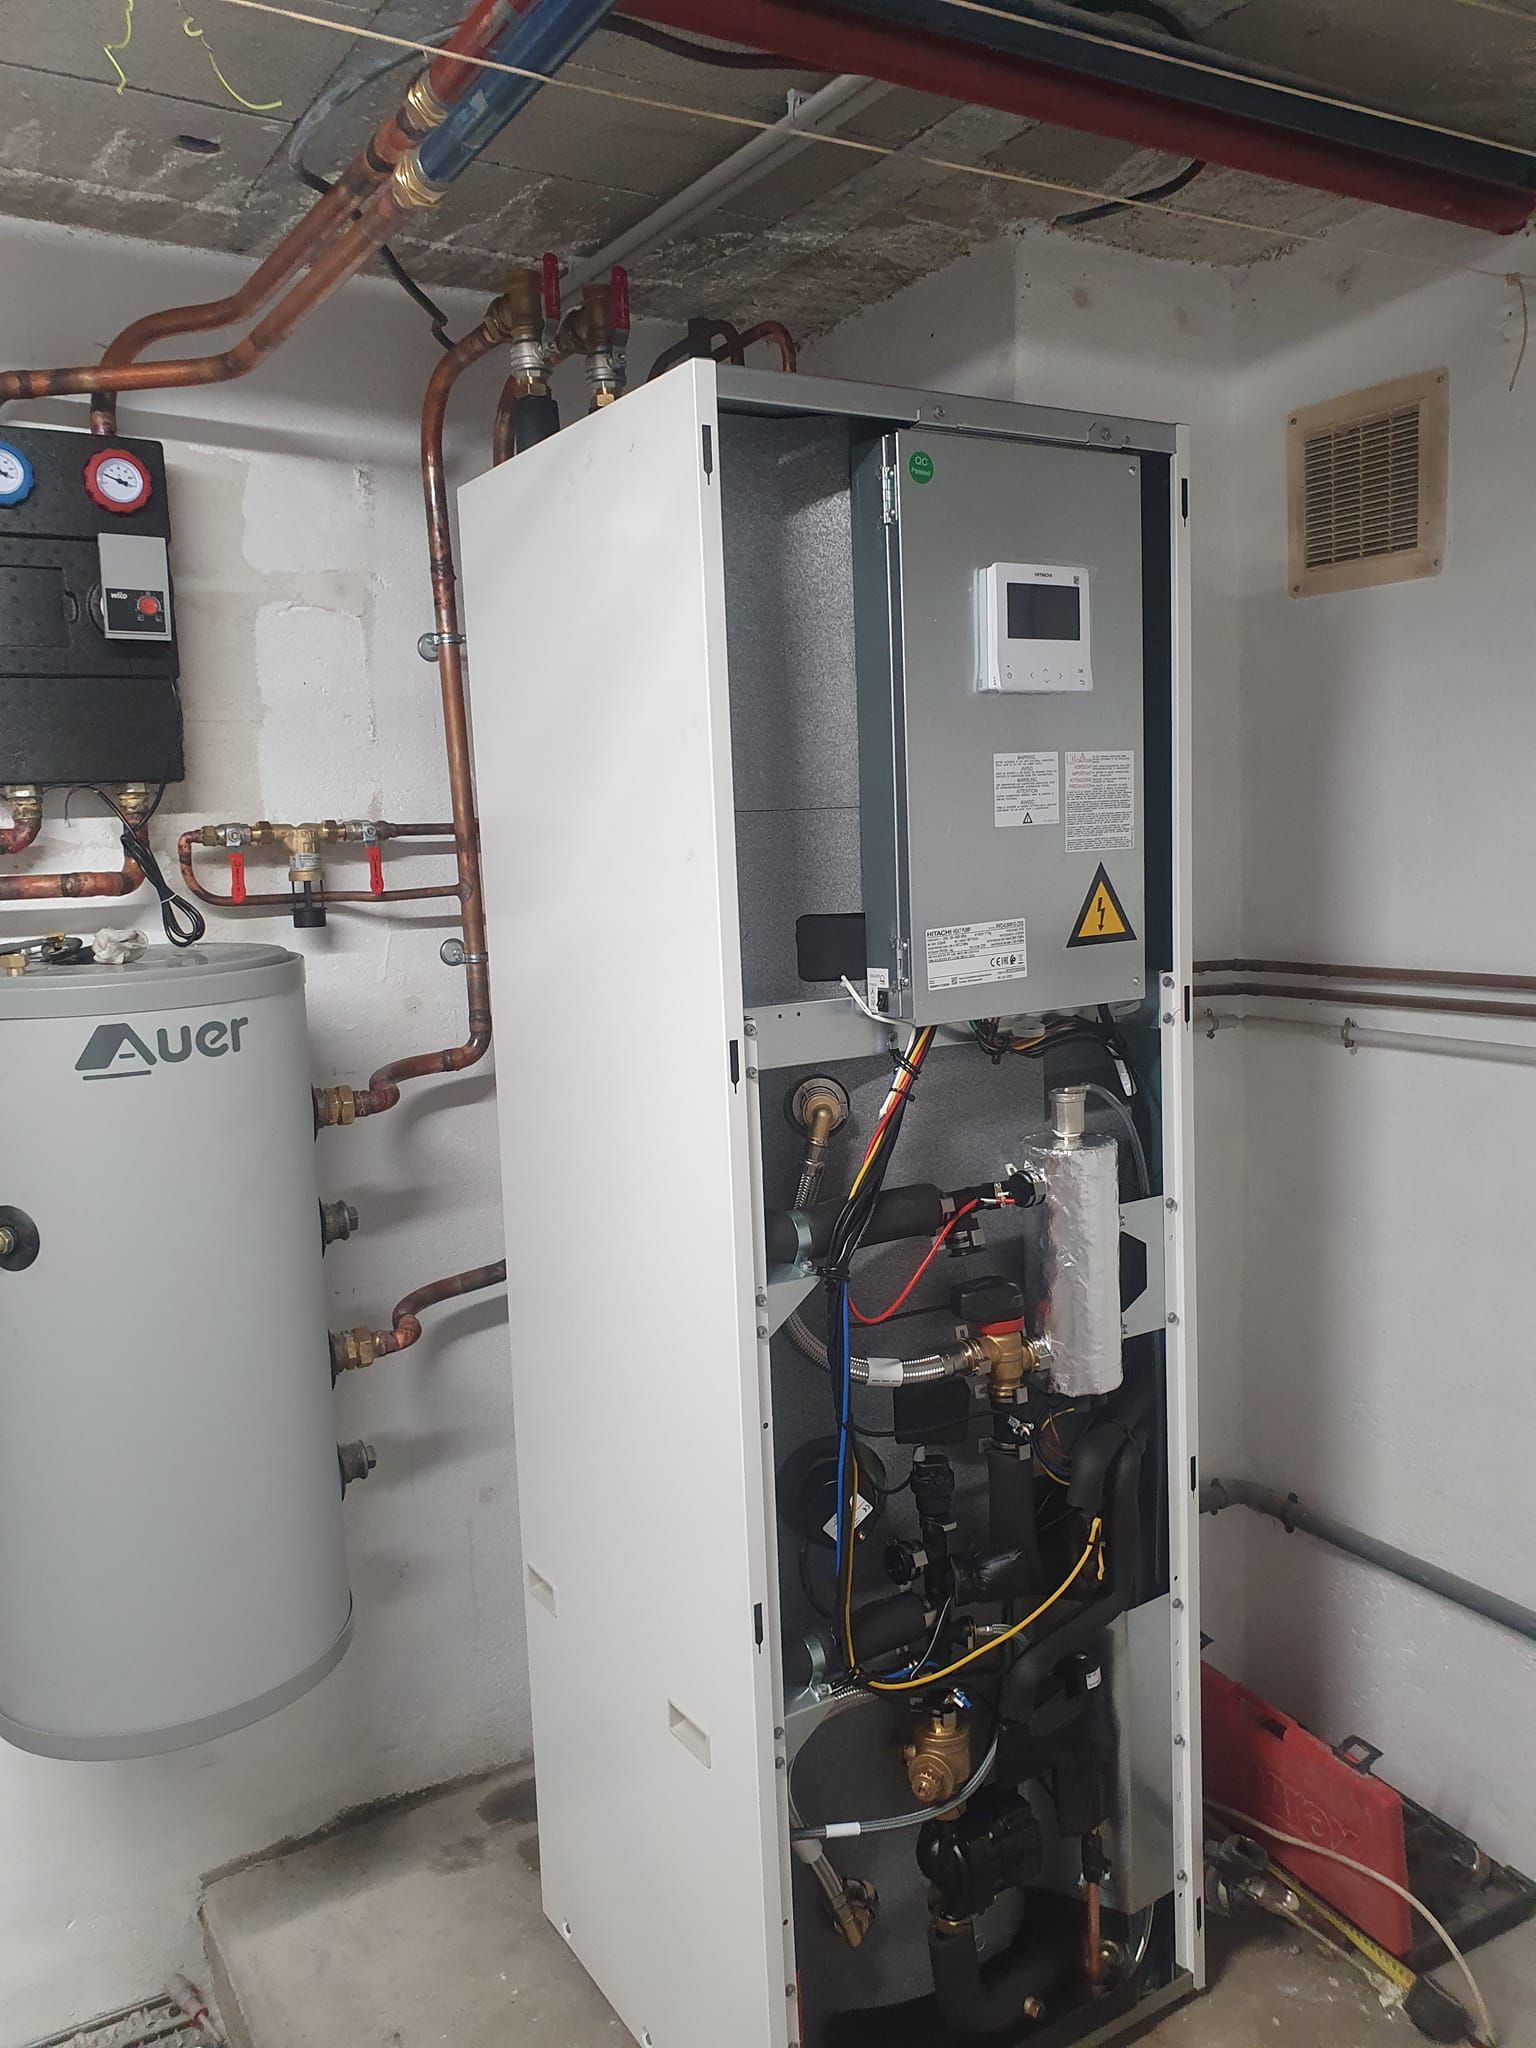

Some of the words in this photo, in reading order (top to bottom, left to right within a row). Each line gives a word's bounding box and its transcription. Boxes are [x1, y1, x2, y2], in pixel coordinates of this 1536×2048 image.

[914, 455, 929, 467] QC
[110, 591, 128, 600] wilo
[926, 929, 952, 937] HITACHI
[75, 1016, 249, 1071] Auer
